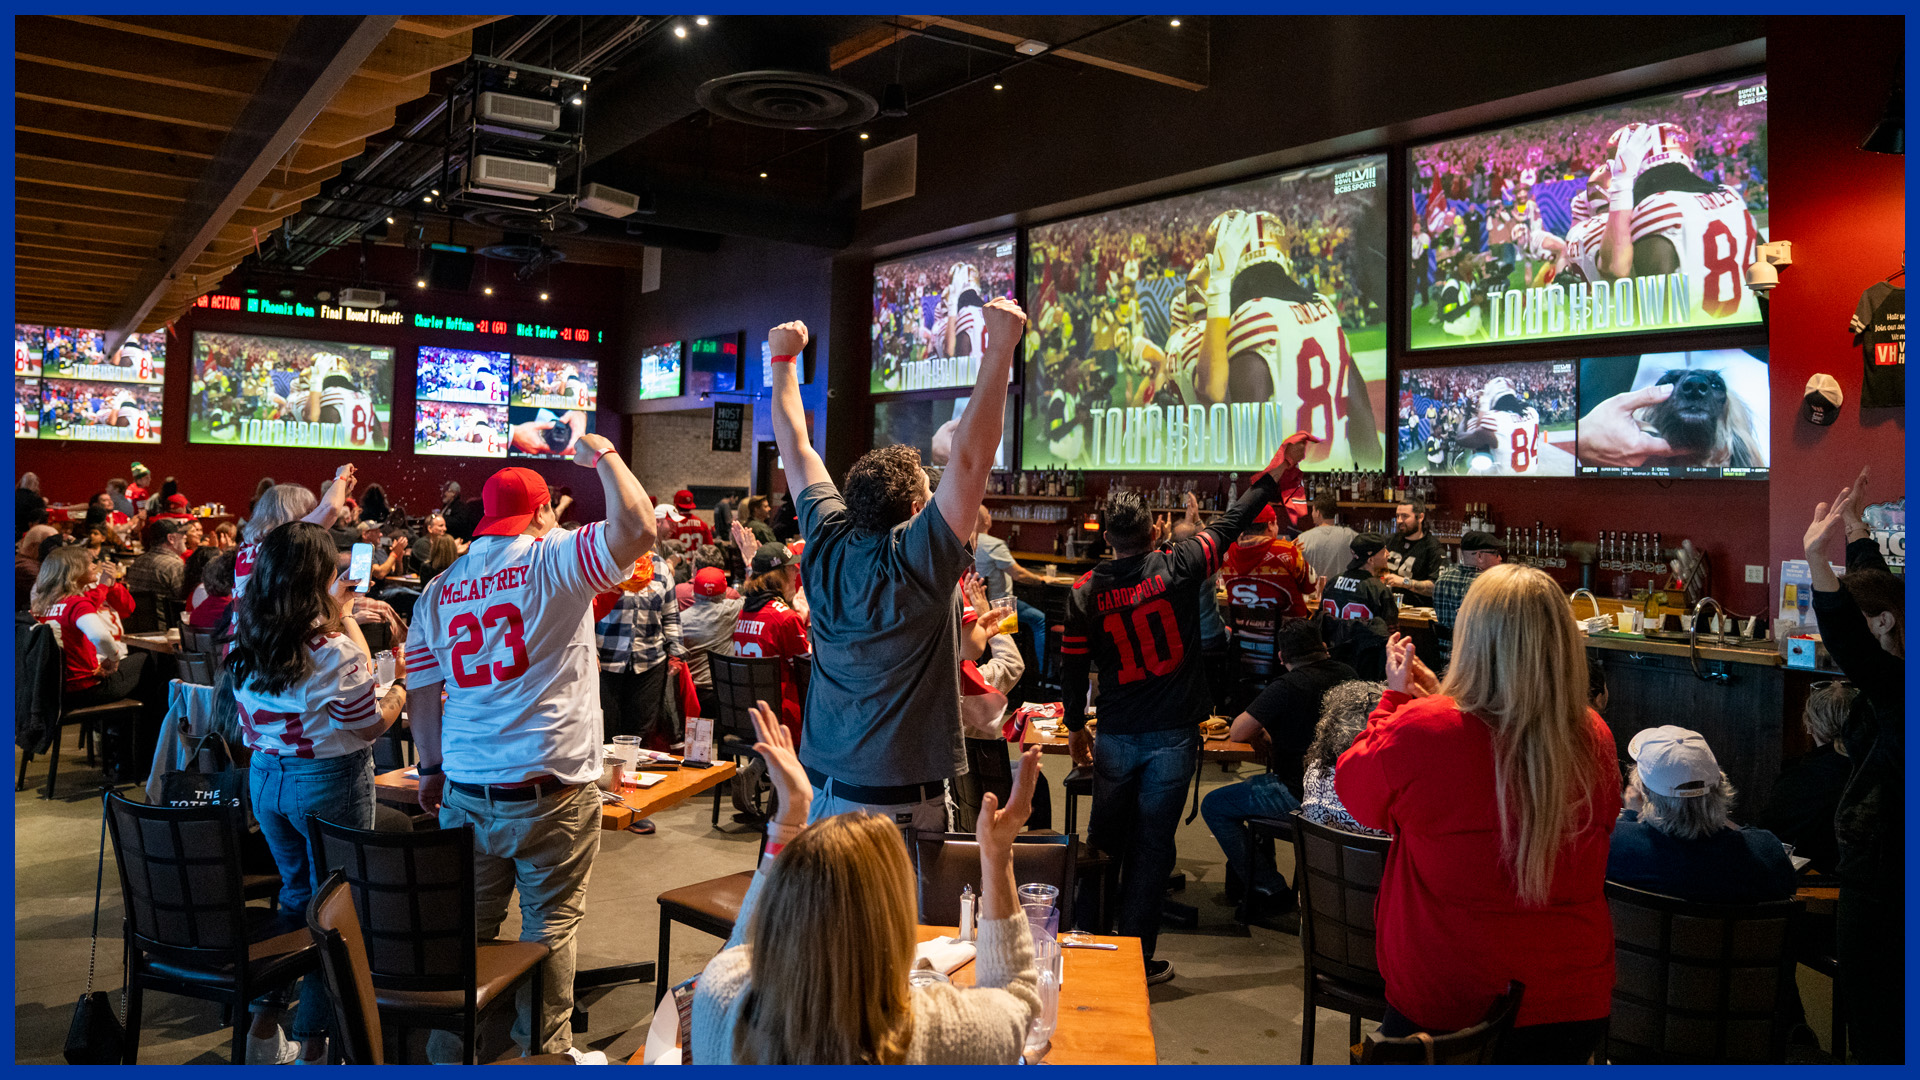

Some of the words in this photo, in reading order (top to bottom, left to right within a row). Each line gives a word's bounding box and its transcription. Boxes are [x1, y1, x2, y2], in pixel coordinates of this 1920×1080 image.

[211, 295, 241, 311] ACTION
[261, 299, 292, 316] Phoenix
[321, 305, 342, 320] Final
[346, 307, 369, 322] Round
[1487, 273, 1690, 339] TOUCHDOWN
[1878, 344, 1897, 362] VH
[716, 420, 739, 430] STAND
[718, 408, 741, 419] HOST
[239, 418, 345, 447] TOUCHDOWN
[718, 430, 738, 439] HERE
[1090, 402, 1283, 466] TOUCHDOWN
[1511, 424, 1538, 473] 84
[1097, 574, 1166, 611] GAROPPOLO
[1334, 576, 1360, 592] RICE
[448, 602, 530, 688] 23
[1103, 598, 1184, 685] 10
[194, 790, 220, 799] THE
[212, 798, 240, 807] BG
